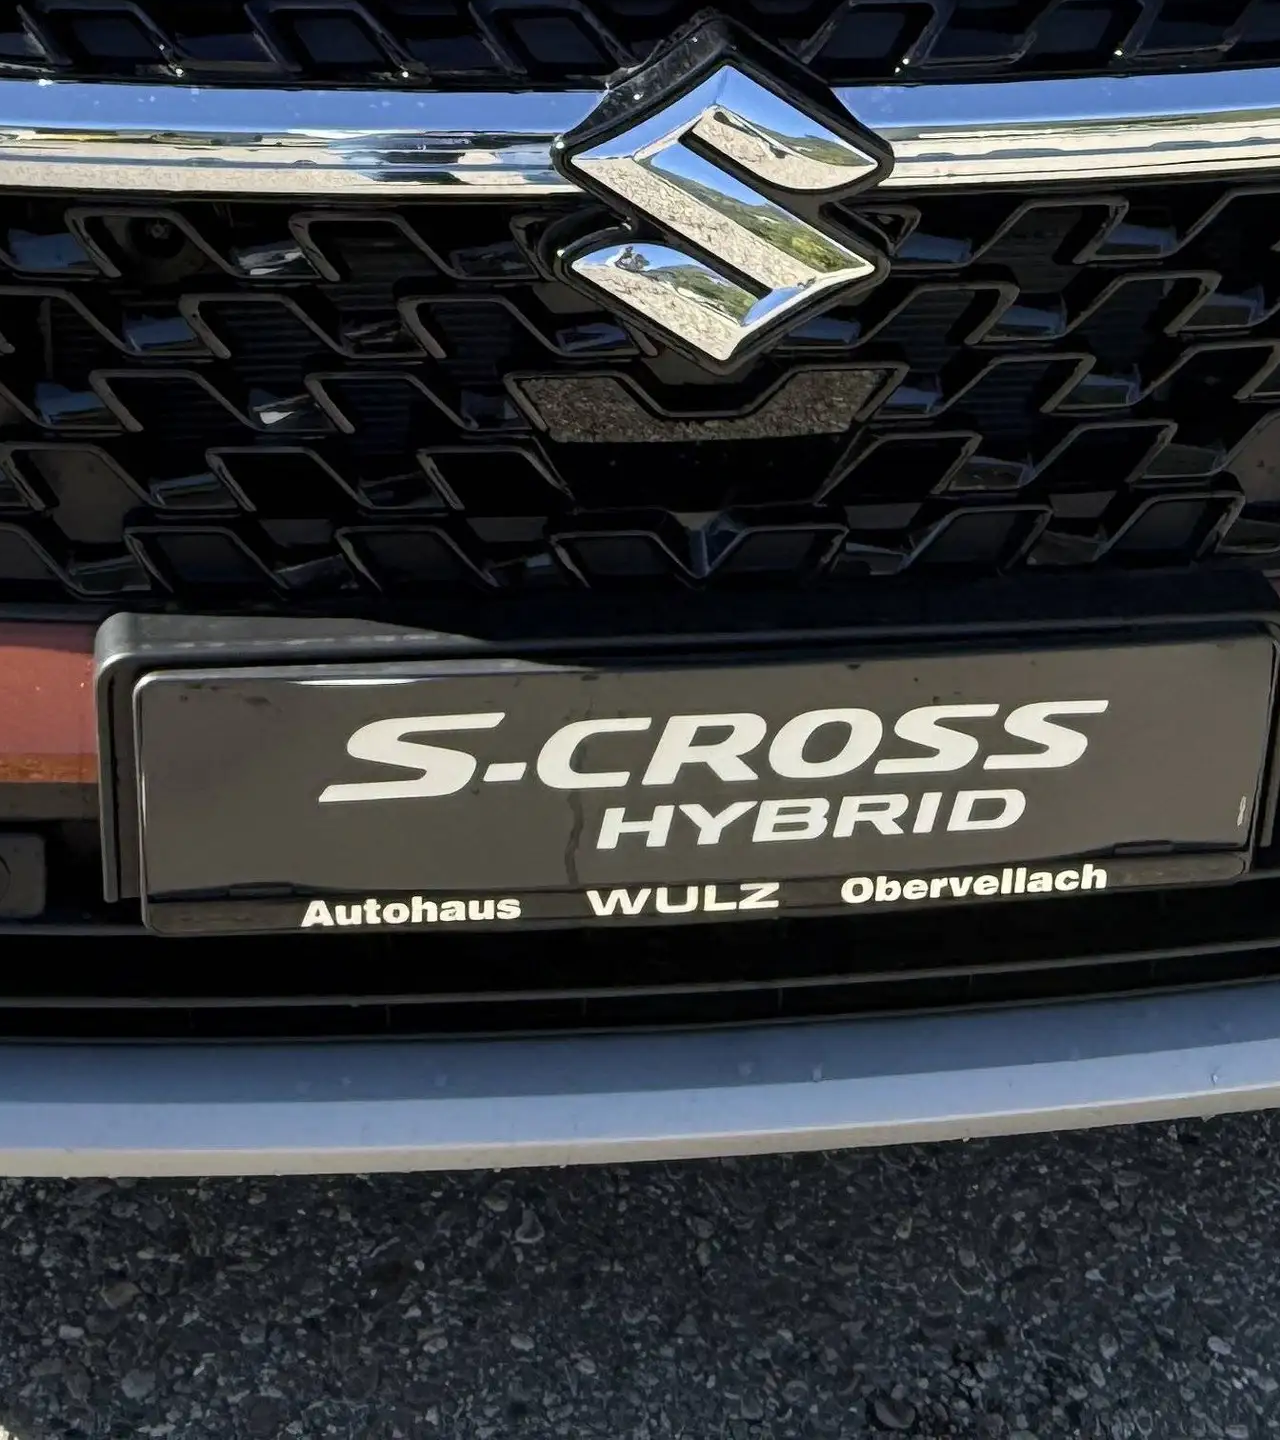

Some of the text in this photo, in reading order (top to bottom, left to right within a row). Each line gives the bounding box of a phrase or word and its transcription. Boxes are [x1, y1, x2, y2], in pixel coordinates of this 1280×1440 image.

[317, 699, 1109, 803] S-CROSS
[596, 788, 1028, 850] HYBRID
[301, 863, 1108, 929] Autohaus WULZ Obervellach
